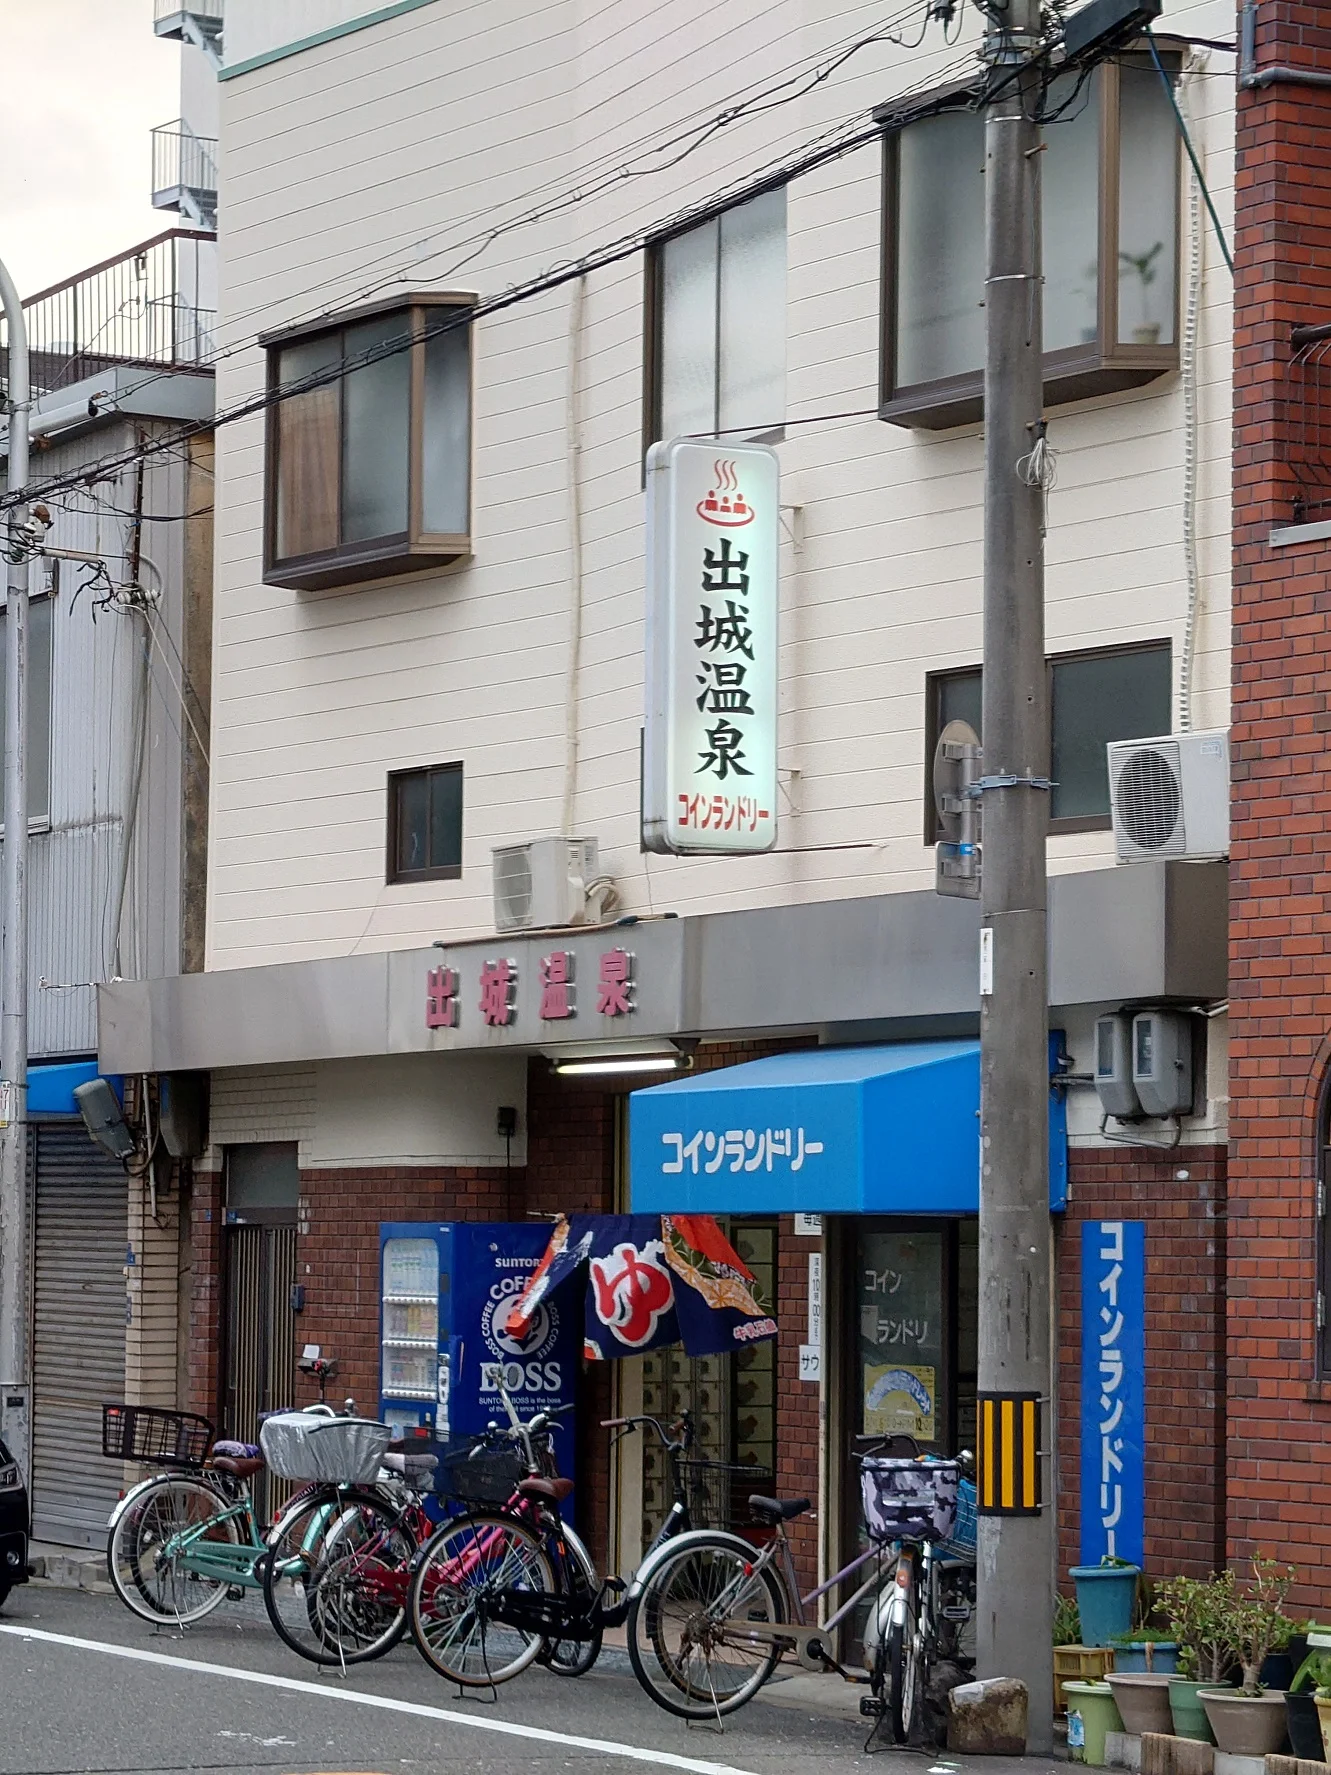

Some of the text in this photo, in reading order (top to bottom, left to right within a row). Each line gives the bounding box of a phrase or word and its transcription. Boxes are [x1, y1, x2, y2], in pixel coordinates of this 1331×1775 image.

[694, 537, 755, 781] 出城温泉
[678, 793, 770, 833] コインランドリー
[425, 947, 636, 1029] 出城温泉
[661, 1127, 824, 1175] コインランドリー
[495, 1257, 544, 1268] SUNTOR
[865, 1269, 901, 1293] コイン
[590, 1244, 673, 1346] ゆ
[481, 1300, 496, 1337] COFFEE
[536, 1328, 560, 1360] COFFEE
[479, 1362, 562, 1392] BOSS
[1098, 1221, 1124, 1566] コインランドリー
[488, 1405, 496, 1413] of
